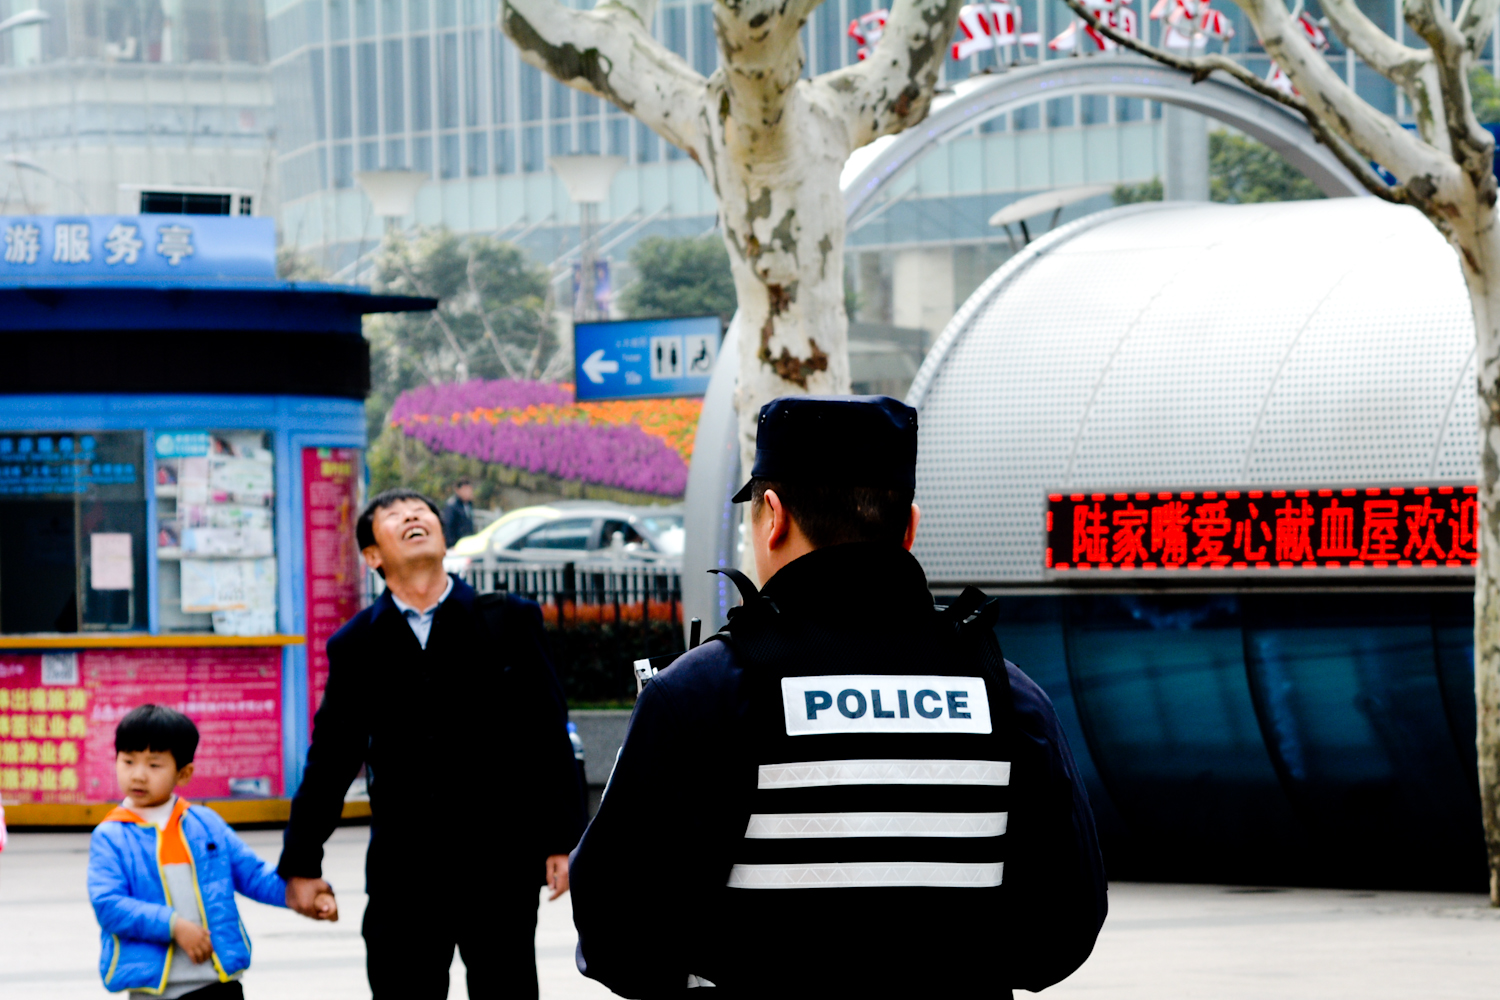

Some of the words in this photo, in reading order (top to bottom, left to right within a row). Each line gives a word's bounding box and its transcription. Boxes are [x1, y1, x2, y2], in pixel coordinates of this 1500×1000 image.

[5, 223, 194, 266] 游服务亭
[1073, 497, 1479, 565] 陆家嘴爱心献血屋欢迎
[804, 688, 972, 720] POLICE
